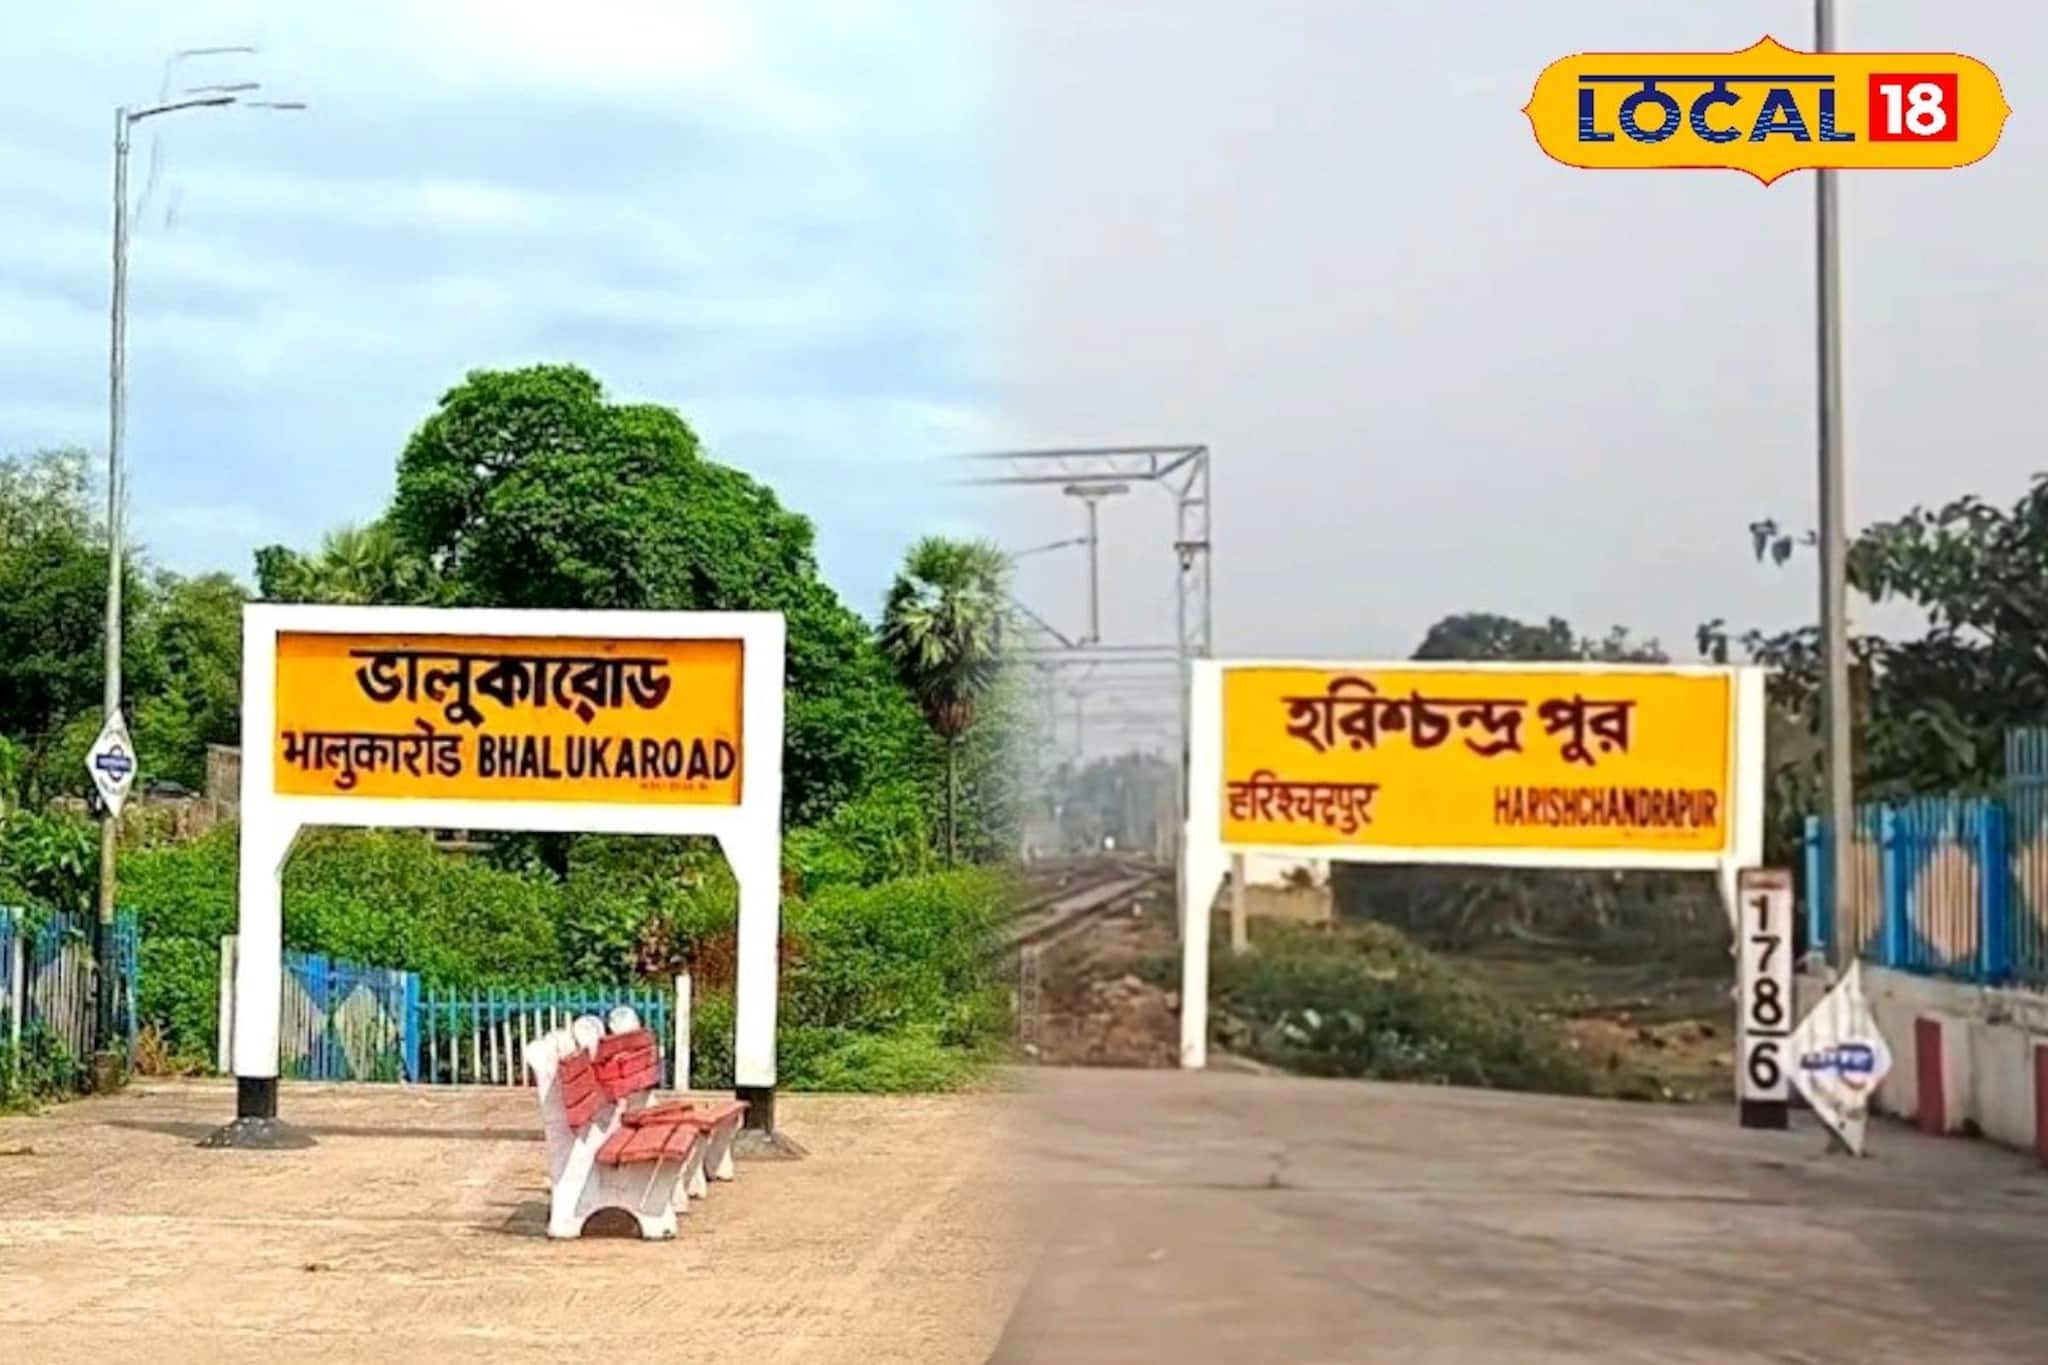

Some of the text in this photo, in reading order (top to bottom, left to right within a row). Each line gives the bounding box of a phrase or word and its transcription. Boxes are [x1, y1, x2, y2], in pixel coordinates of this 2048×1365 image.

[281, 717, 463, 790] भालुकारोड
[478, 733, 736, 780] BHALUKAROAD
[1494, 786, 1718, 827] HARISHCHANDRAPUR
